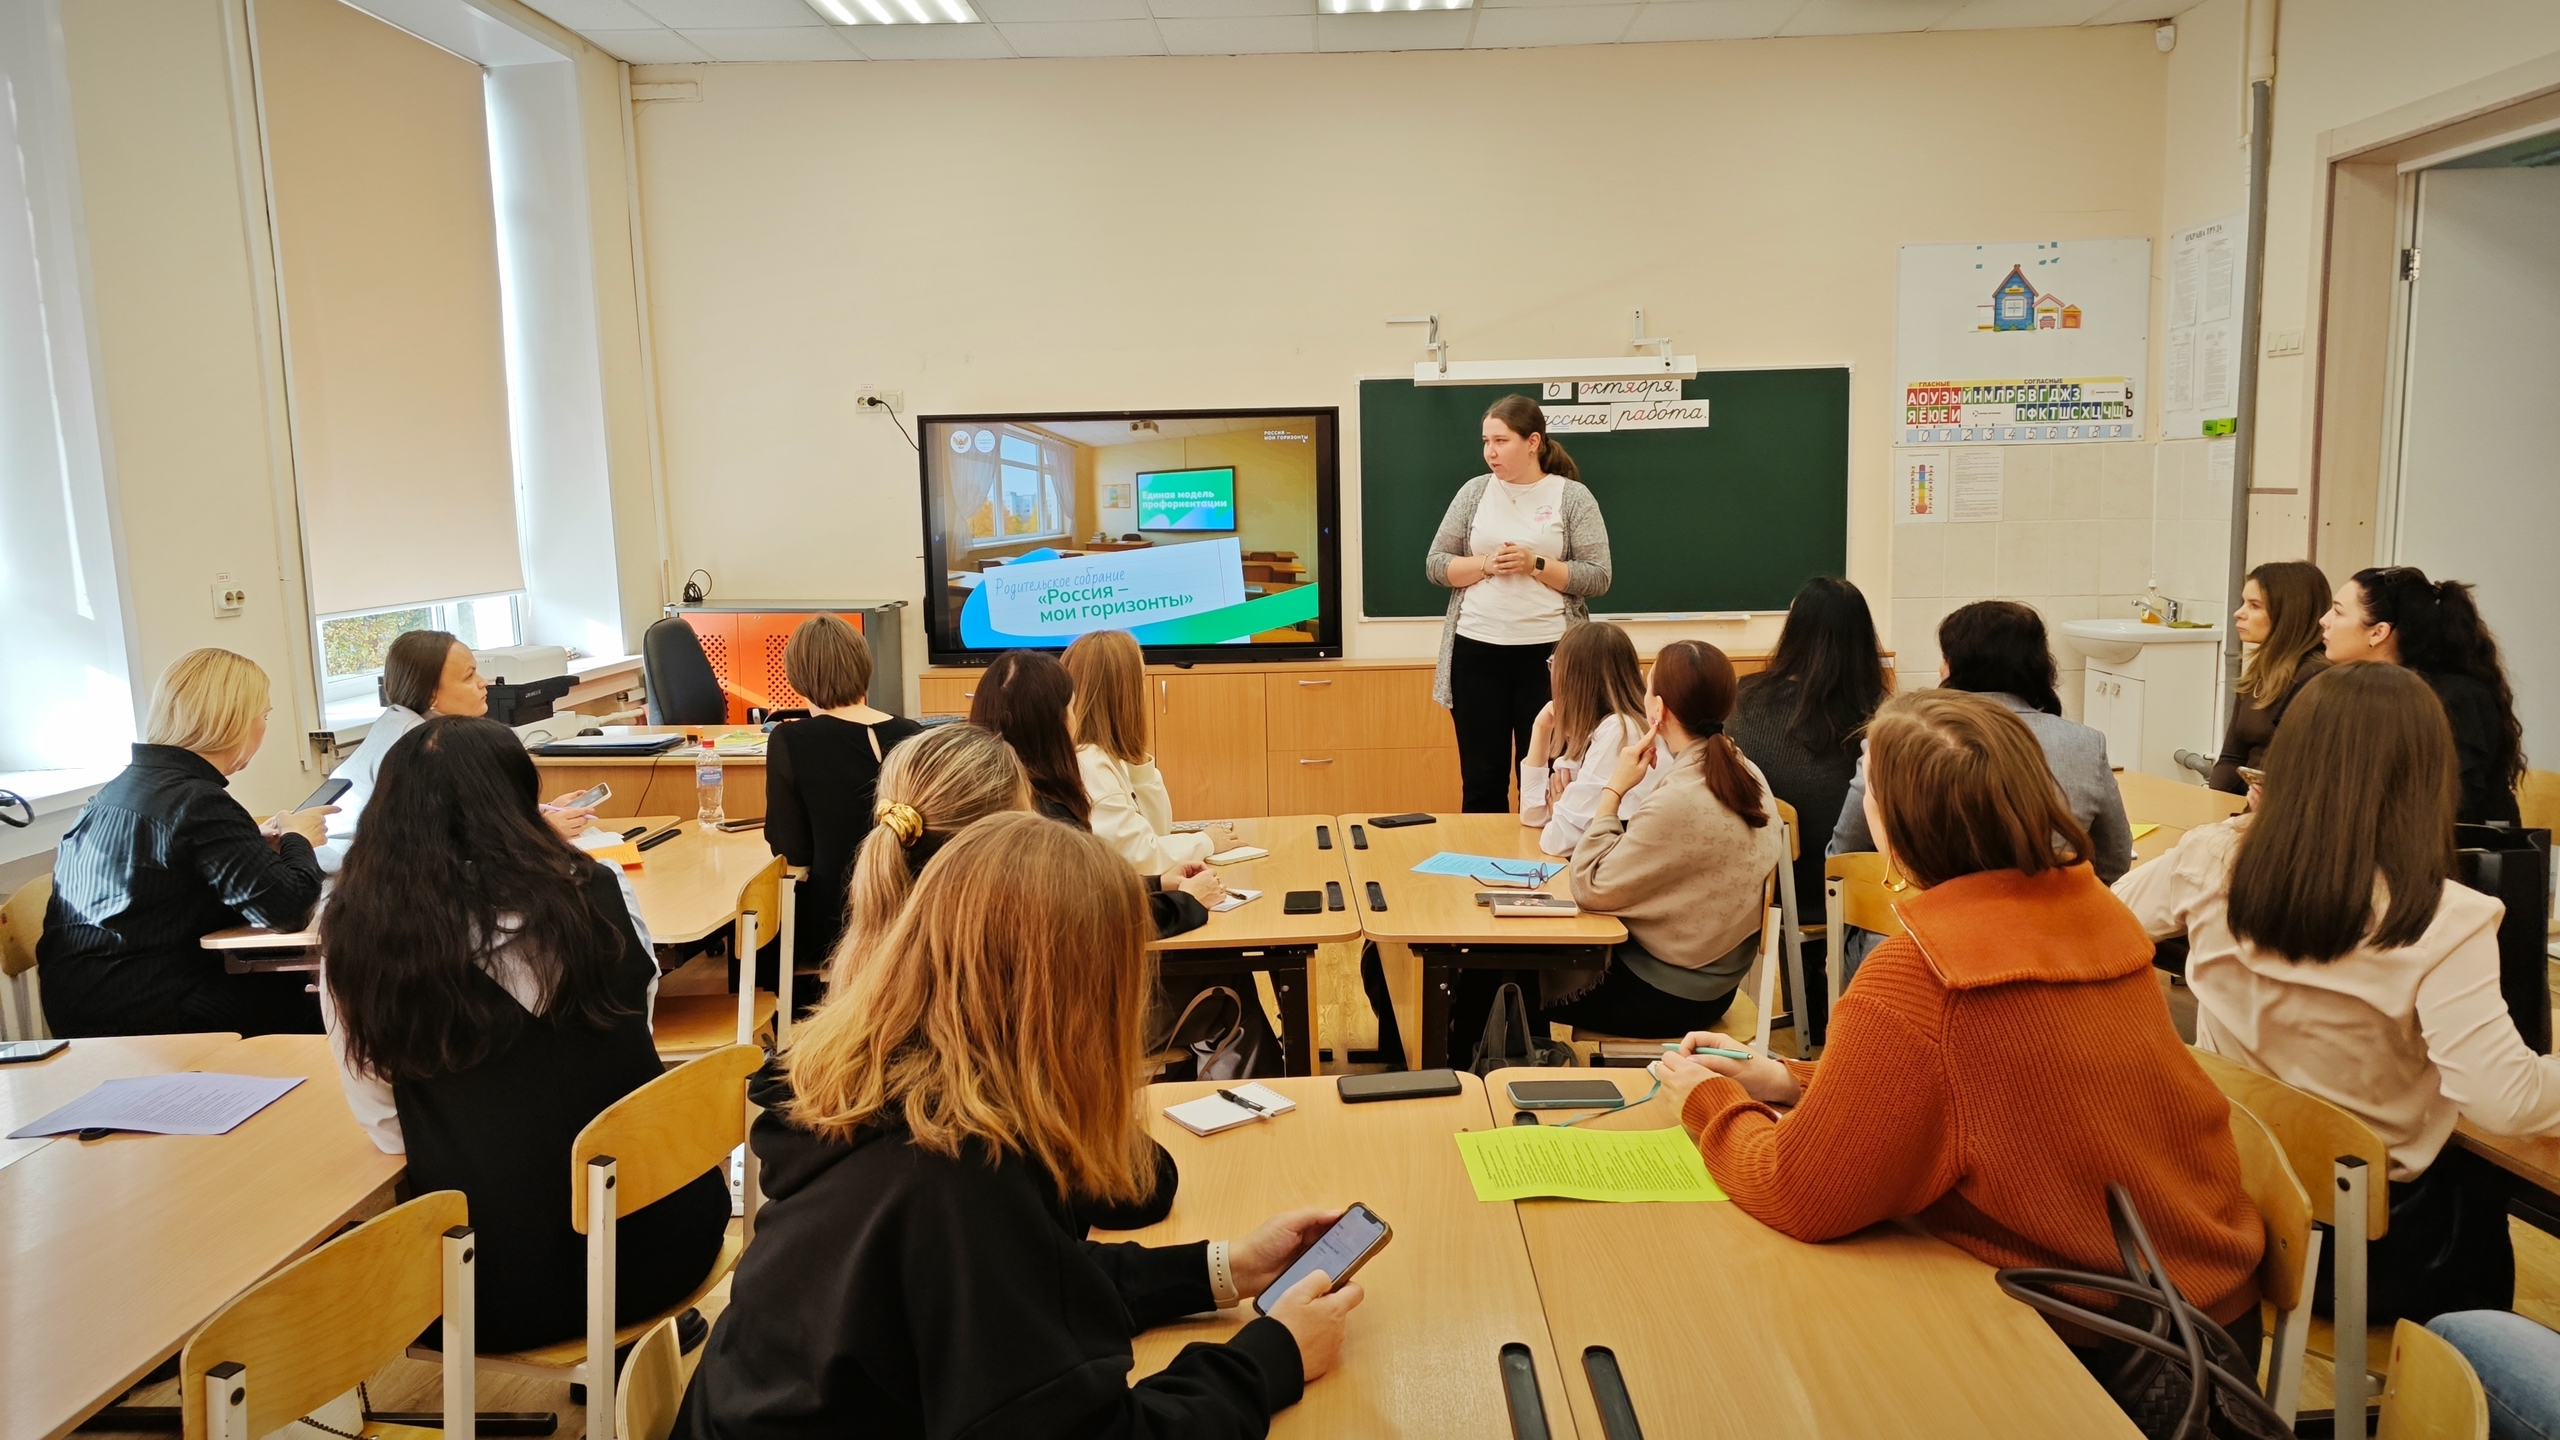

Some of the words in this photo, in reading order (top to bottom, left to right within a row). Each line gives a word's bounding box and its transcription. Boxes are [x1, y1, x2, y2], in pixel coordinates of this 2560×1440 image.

[1544, 414, 1609, 426] ассная
[1922, 430, 1930, 442] 0
[1945, 429, 1952, 441] 1
[1964, 428, 1973, 441] 2
[1985, 428, 1994, 440] 3
[2008, 428, 2016, 440] 4
[2027, 427, 2037, 439] 5
[2049, 426, 2058, 439] 6
[2070, 426, 2079, 438] 7
[2092, 426, 2100, 438] 8
[2113, 425, 2121, 437] 9
[1142, 491, 1175, 500] Единая
[1177, 491, 1215, 499] модель
[1142, 500, 1228, 510] профориентации
[996, 578, 1070, 600] Родительское
[1074, 566, 1125, 589] собрание
[1038, 585, 1114, 605] «Россия
[1040, 606, 1076, 622] мои
[1082, 594, 1194, 620] горизонты»
